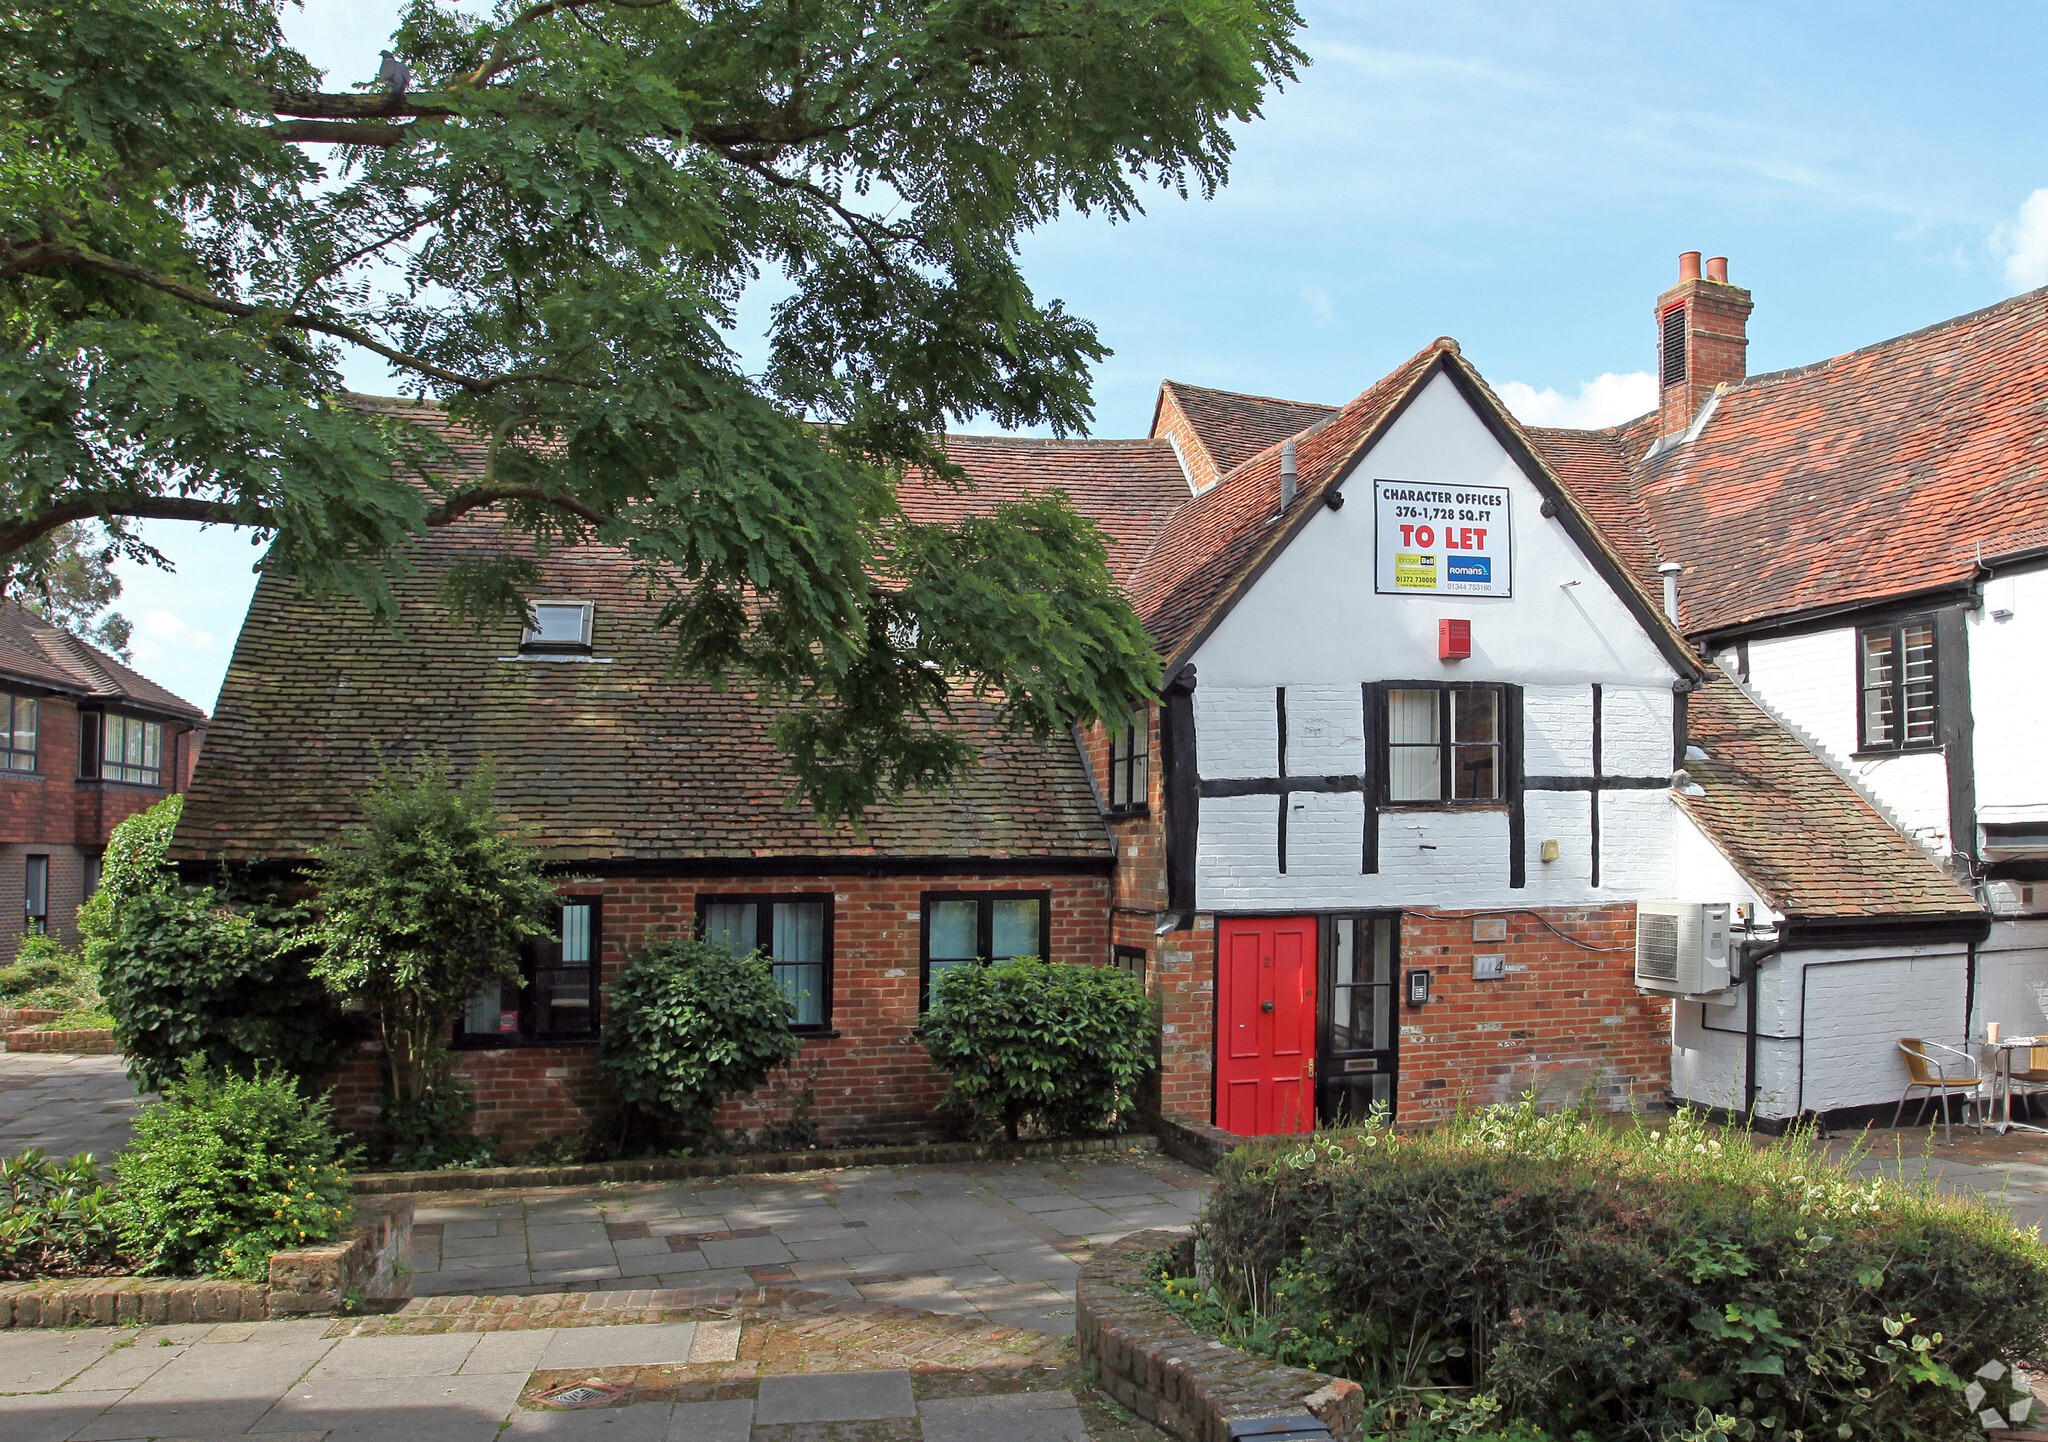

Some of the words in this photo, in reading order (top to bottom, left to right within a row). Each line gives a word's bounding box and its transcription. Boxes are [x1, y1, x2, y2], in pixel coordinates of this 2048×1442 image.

[1383, 488, 1452, 503] CHARACTER
[1456, 493, 1502, 506] OFFICES
[1396, 506, 1455, 521] 376-1,728
[1459, 509, 1491, 522] SQ.FT
[1400, 524, 1435, 548] TO
[1445, 527, 1487, 550] LET
[1263, 956, 1271, 969] 2
